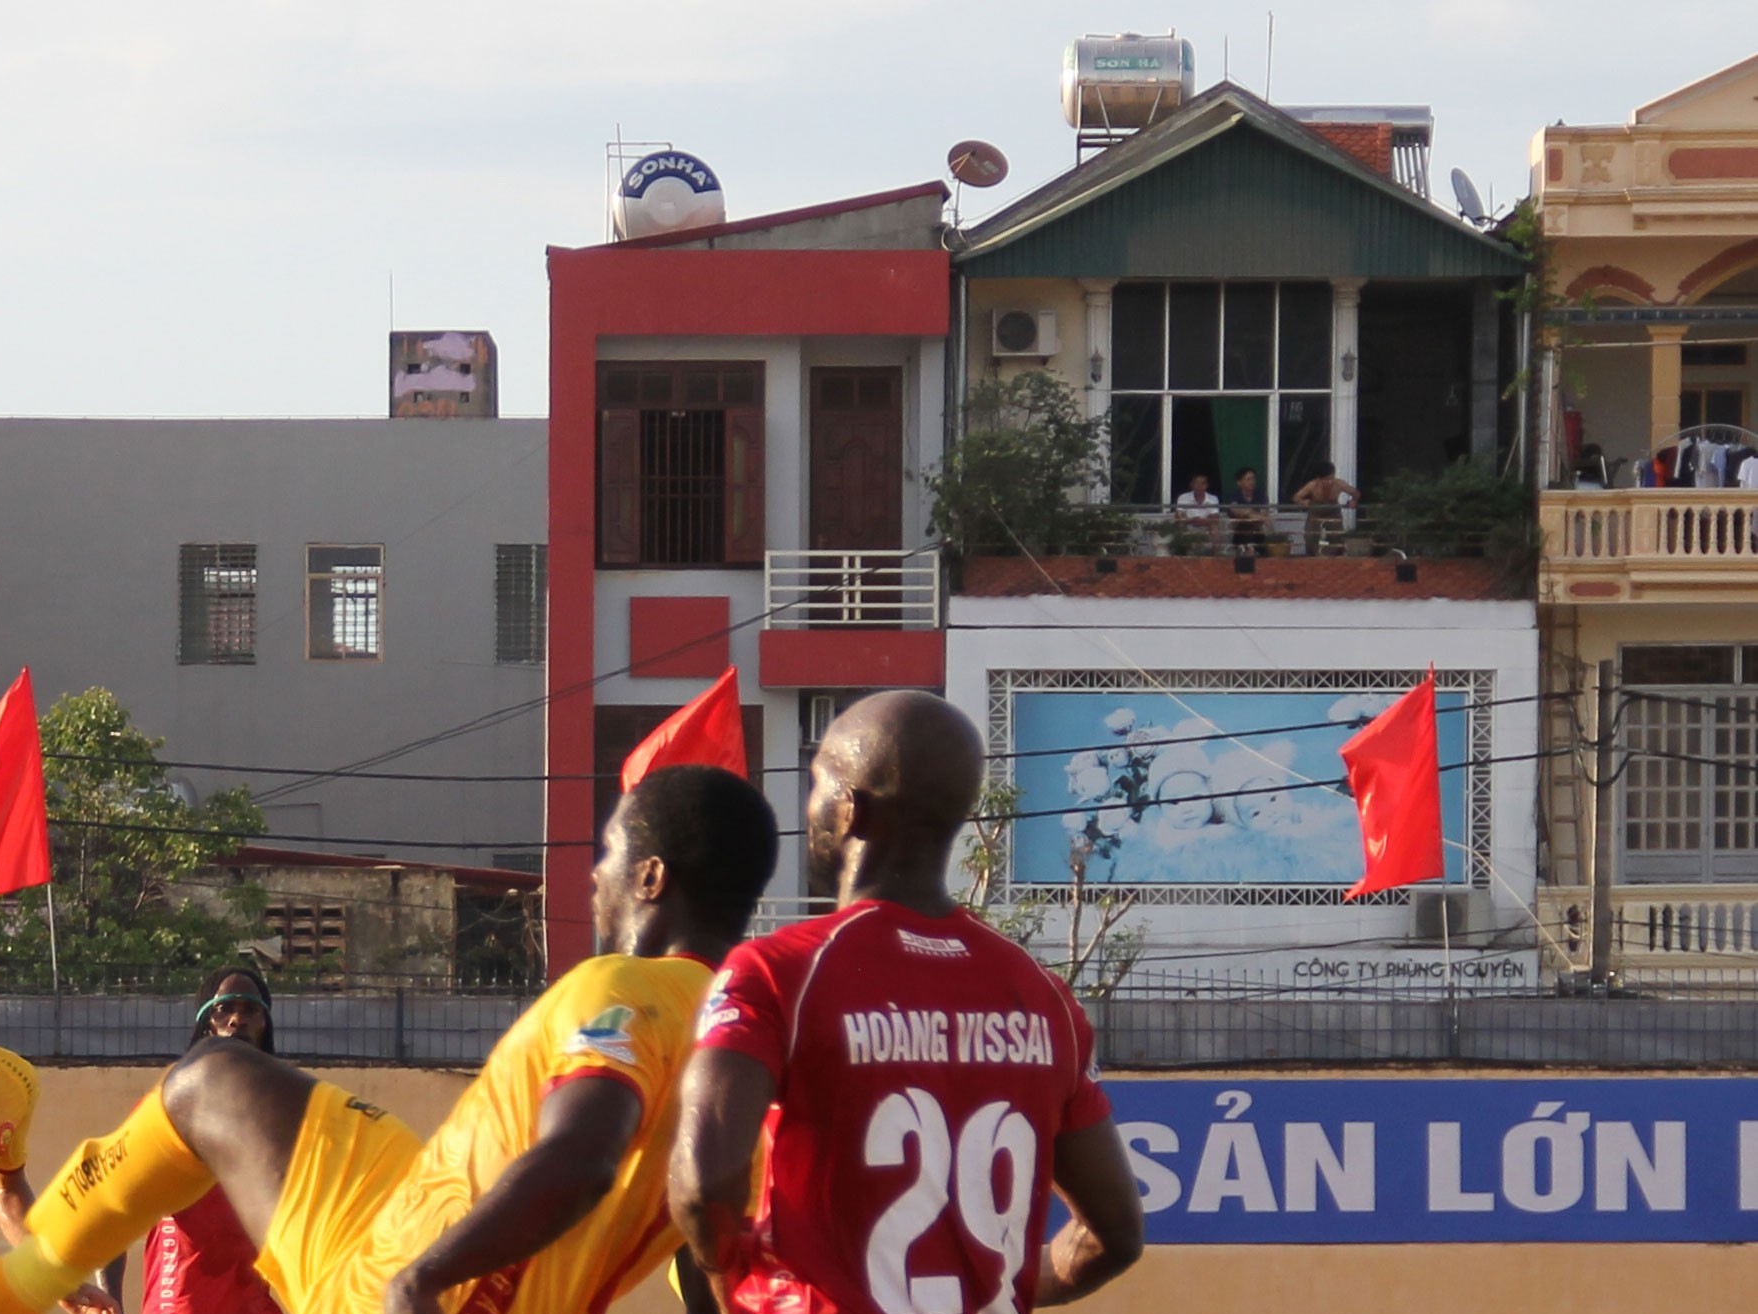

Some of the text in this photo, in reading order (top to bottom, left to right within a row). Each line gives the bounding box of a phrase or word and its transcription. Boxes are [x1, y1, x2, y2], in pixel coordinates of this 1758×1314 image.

[1295, 957, 1525, 977] CÔNG TY PHÙNG NGUYÊN
[843, 1001, 1054, 1067] HOÀNG VISSAI
[1114, 1089, 1376, 1214] SẢN
[1427, 1101, 1688, 1213] LỚN
